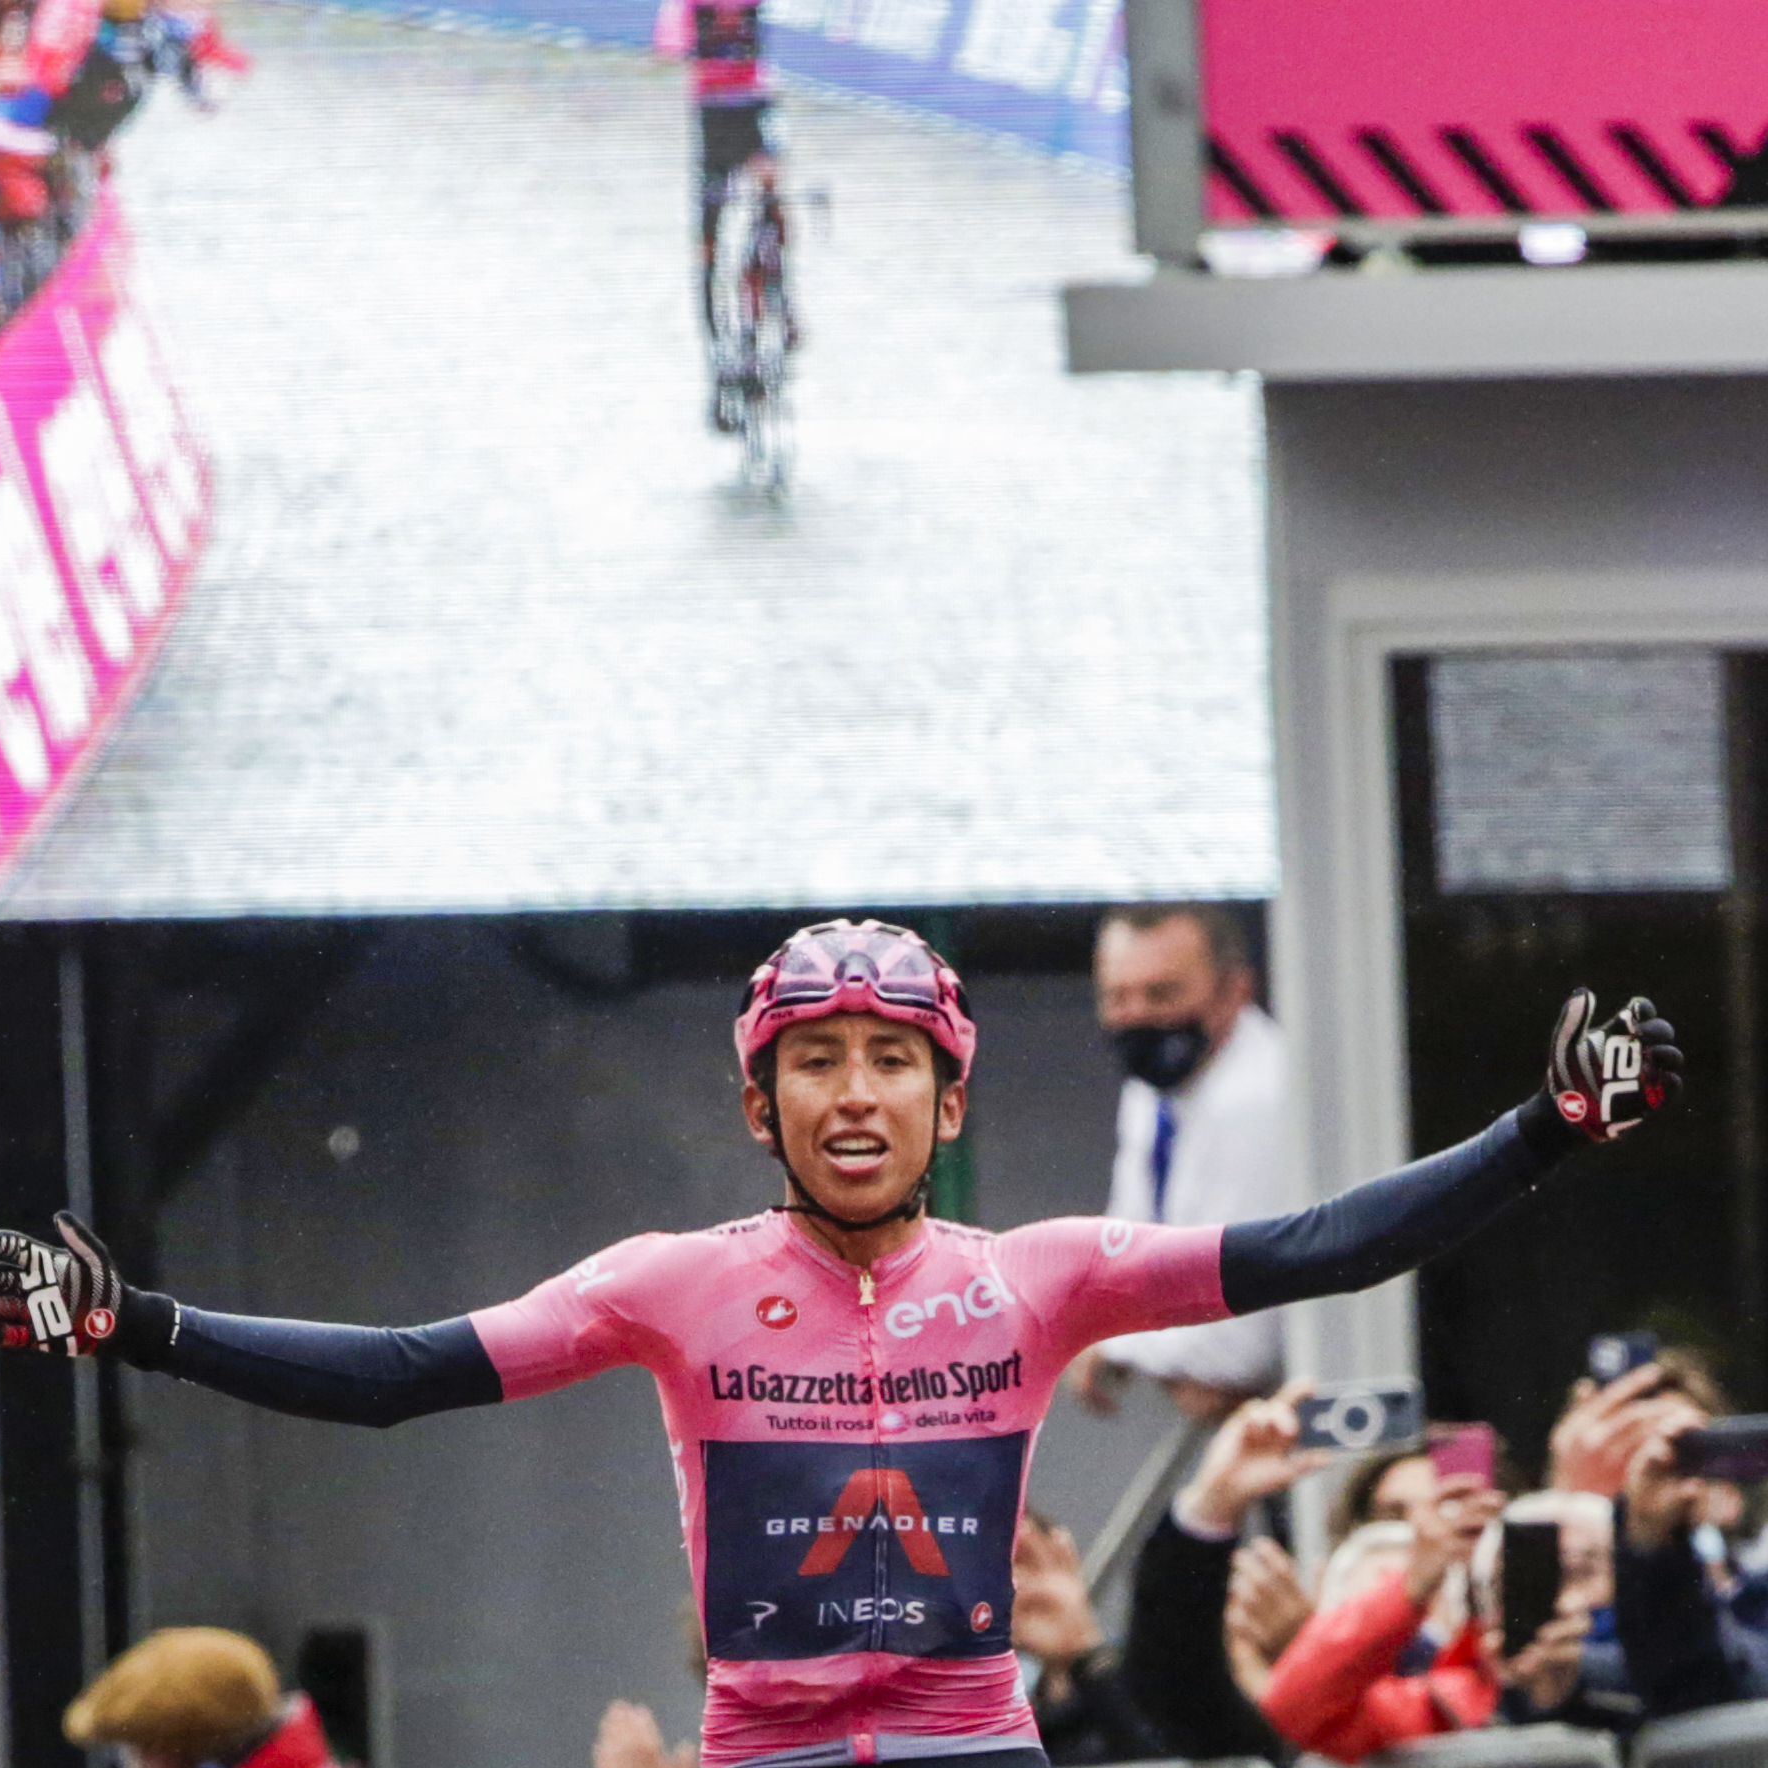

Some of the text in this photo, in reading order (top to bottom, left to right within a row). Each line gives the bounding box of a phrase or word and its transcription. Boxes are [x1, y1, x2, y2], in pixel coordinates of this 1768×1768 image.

[884, 1260, 1017, 1339] enel
[709, 1350, 1023, 1405] La Gazzetta dello Sport
[765, 1407, 996, 1431] Tutto il rosa della vita
[765, 1514, 979, 1536] GRENADIER
[816, 1597, 927, 1627] INEOS
